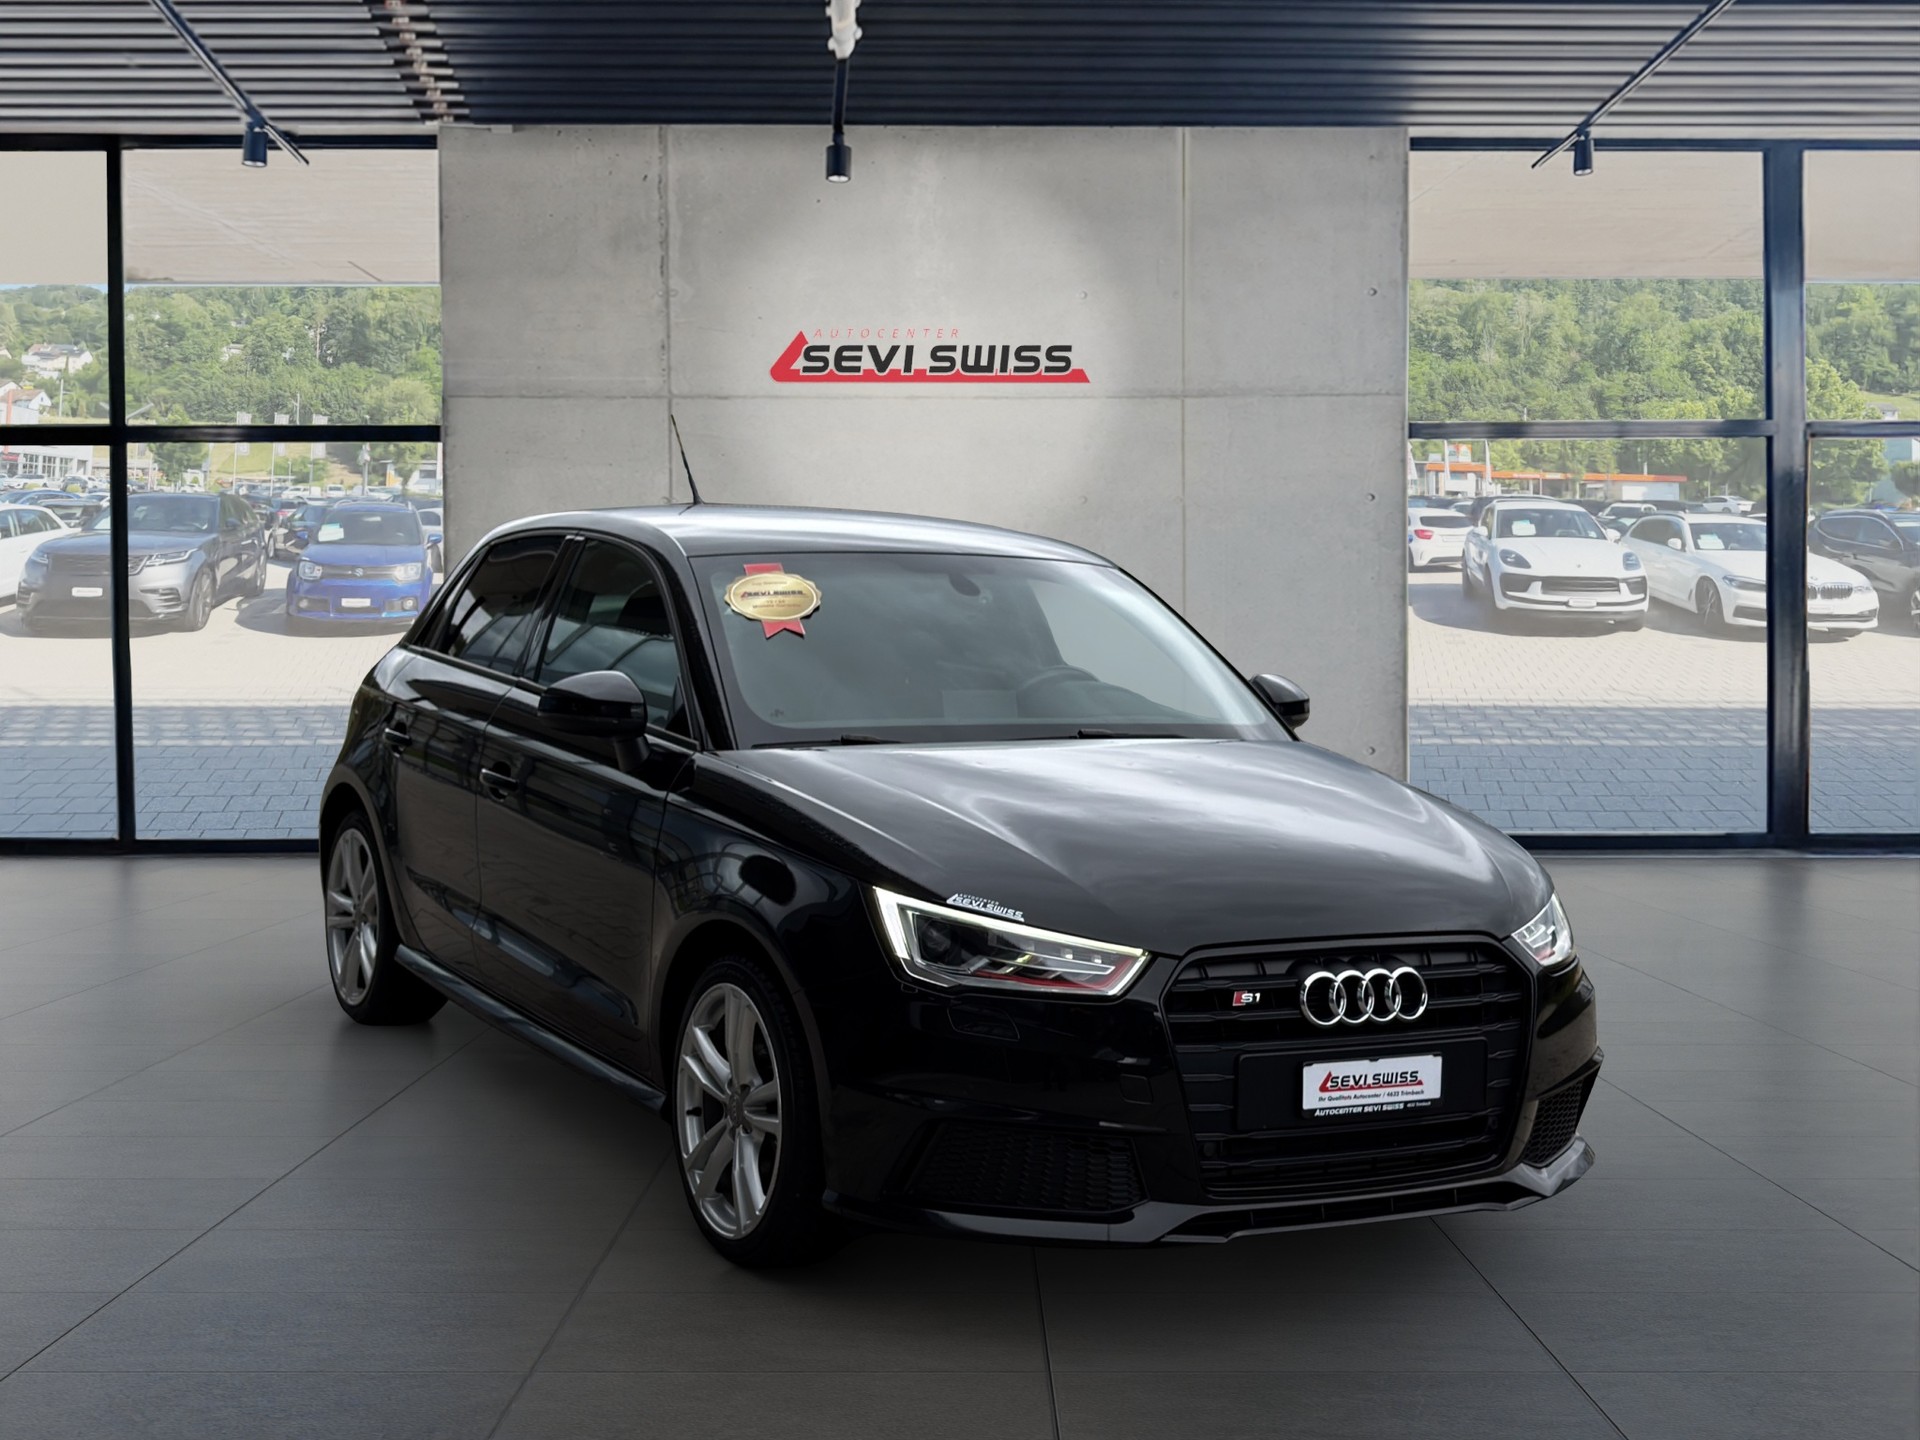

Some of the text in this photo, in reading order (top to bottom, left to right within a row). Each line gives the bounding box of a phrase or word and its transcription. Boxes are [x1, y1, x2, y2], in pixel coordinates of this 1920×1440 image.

[813, 328, 959, 339] AUTOCENTER
[801, 344, 1073, 374] SEVI SWISS
[955, 896, 1023, 919] SEVI SWISS
[1241, 992, 1261, 1003] S1
[1329, 1070, 1419, 1088] SEVI SWISS
[1353, 1092, 1382, 1100] Autocenter
[1314, 1105, 1363, 1117] AUTOCENTER
[1363, 1104, 1381, 1113] SEVI
[1382, 1102, 1405, 1111] SWISS
